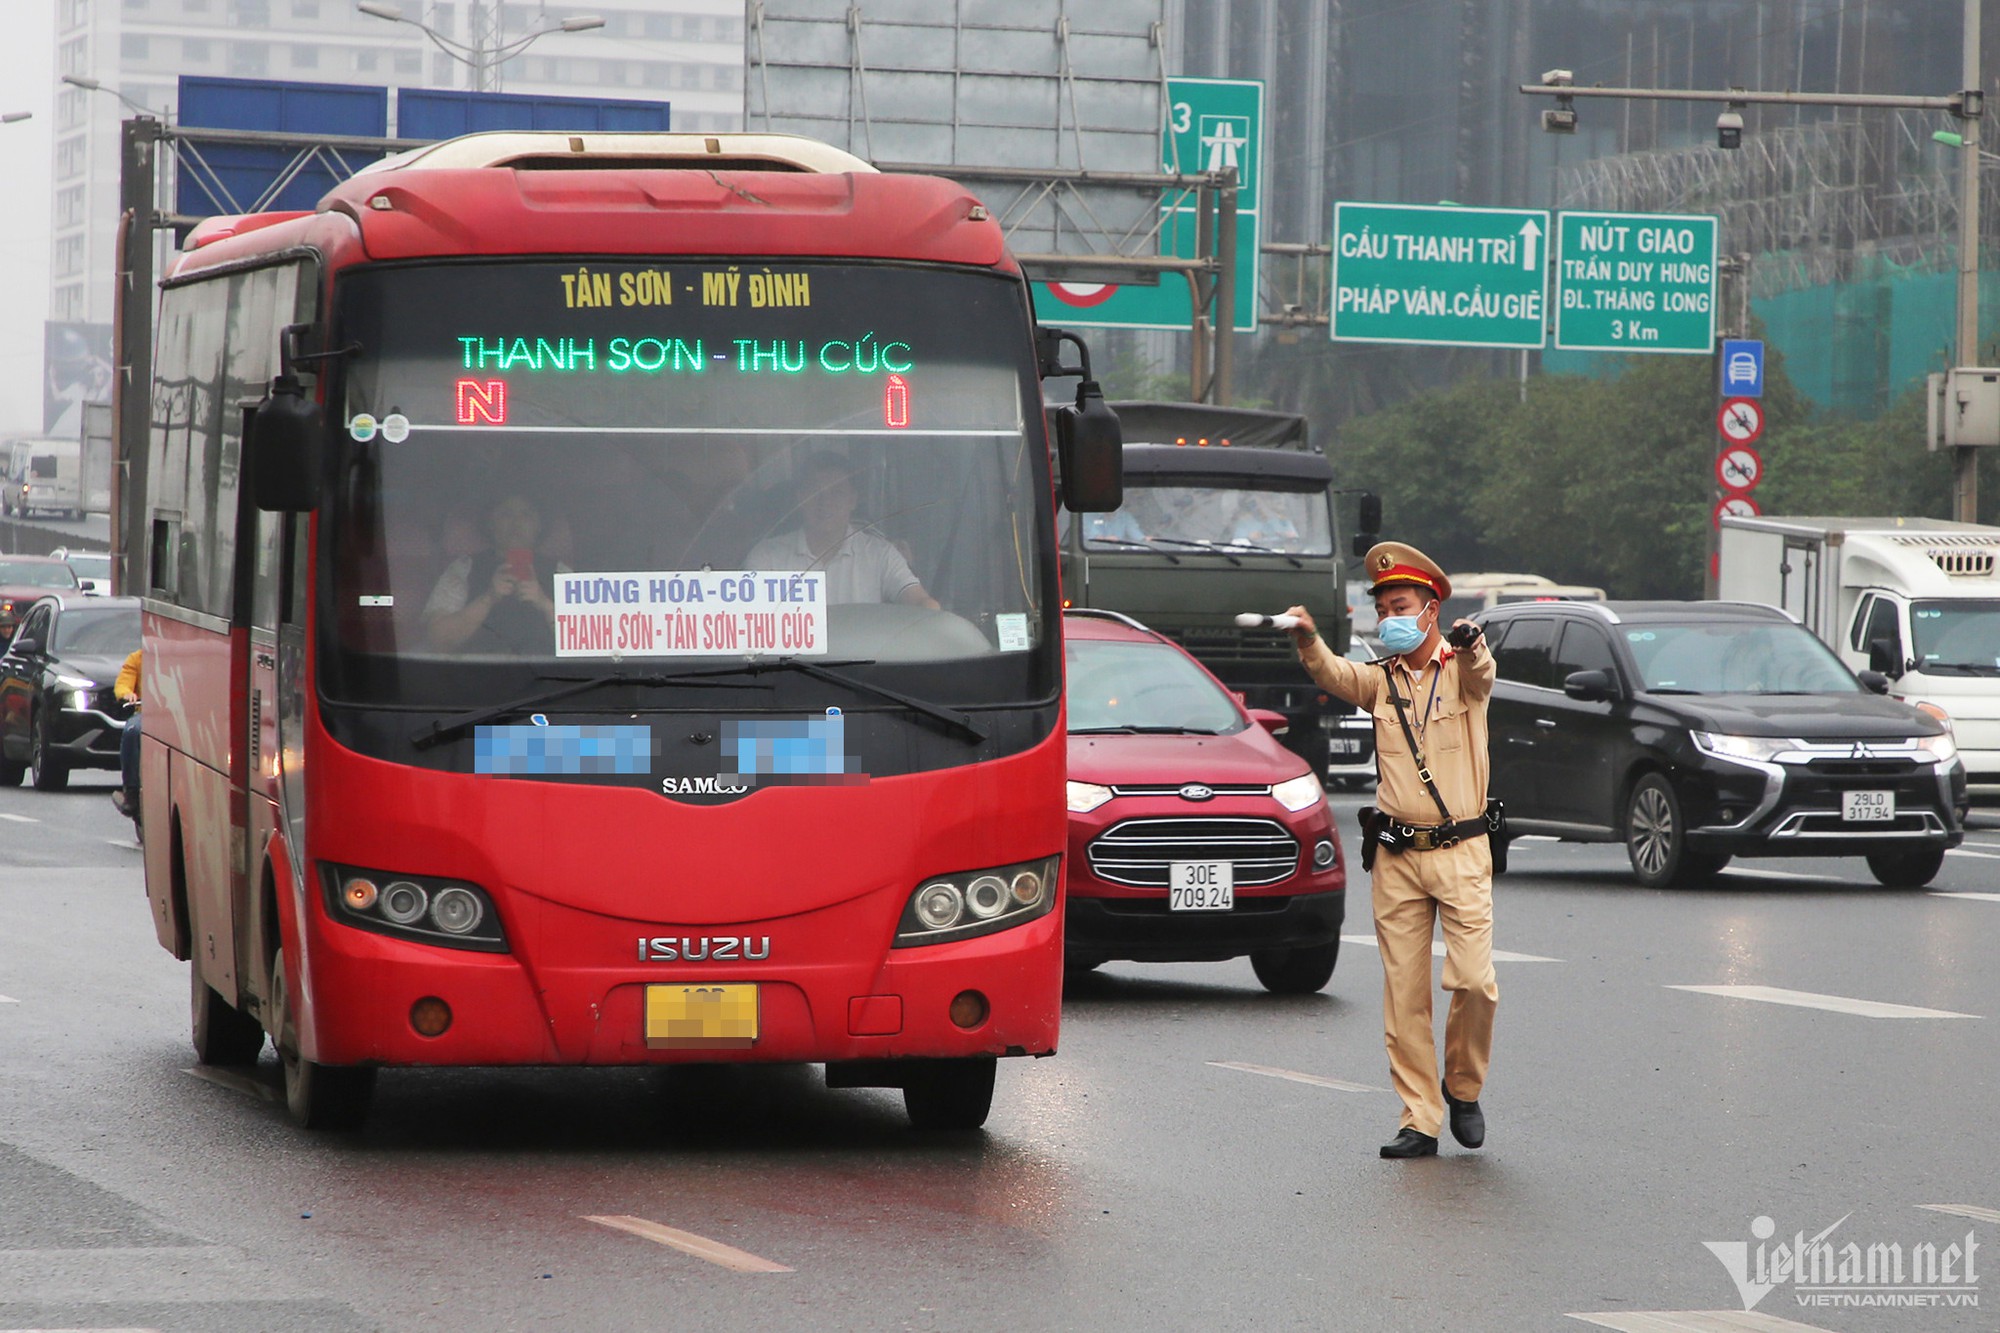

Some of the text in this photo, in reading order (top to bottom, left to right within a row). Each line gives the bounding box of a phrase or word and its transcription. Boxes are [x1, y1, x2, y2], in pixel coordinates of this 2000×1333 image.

[1393, 235, 1474, 264] THANH
[1478, 234, 1516, 265] TRÌ
[1580, 219, 1694, 254] NÚT GIAO
[561, 267, 612, 308] TÂN
[619, 269, 672, 306] SƠN
[702, 266, 740, 306] MỸ
[749, 267, 811, 307] ĐÌNH
[1617, 261, 1654, 282] DUY
[1660, 262, 1710, 284] HƯNG
[1338, 283, 1399, 314] PHÁP
[1593, 287, 1655, 311] THĂNG
[1663, 292, 1709, 313] LONG
[1611, 319, 1659, 341] 3 Km
[457, 337, 595, 371] THANH
[607, 337, 702, 371] SƠN
[732, 338, 804, 372] THU
[819, 331, 913, 372] CÚC
[457, 380, 505, 423] N
[565, 577, 640, 603] HƯNG
[764, 573, 819, 602] TIẾT
[558, 614, 613, 650] THANH
[782, 607, 814, 649] CÚC
[1849, 807, 1889, 819] 317.94
[1185, 864, 1218, 885] 30E
[1173, 888, 1231, 908] 709.24
[638, 936, 770, 961] ISUZU
